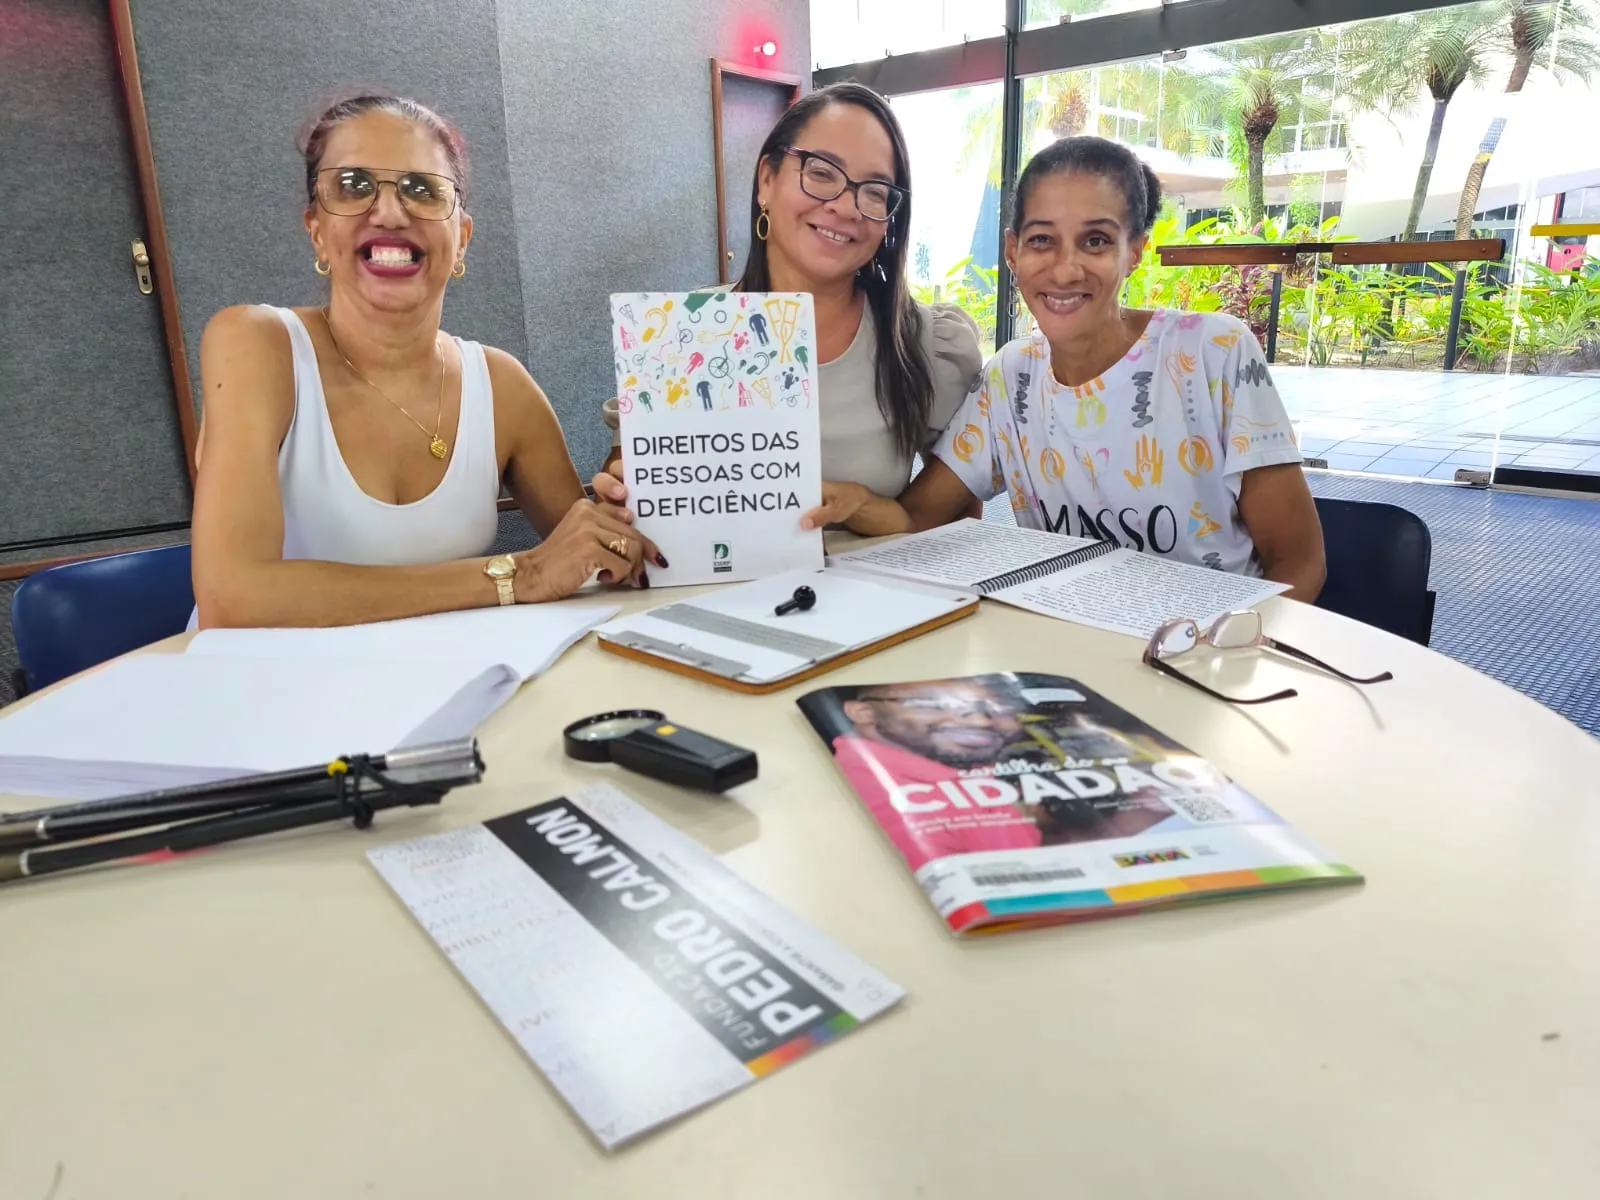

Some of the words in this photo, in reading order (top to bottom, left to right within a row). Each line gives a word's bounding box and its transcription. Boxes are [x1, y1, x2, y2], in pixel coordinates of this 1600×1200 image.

[633, 433, 745, 456] DIREITOS
[752, 431, 799, 453] DAS
[635, 464, 743, 485] PESSOAS
[751, 462, 800, 480] COM
[637, 490, 800, 518] DEFICIÊNCIA
[525, 806, 671, 911] CALMON
[653, 954, 769, 1051] FUNDAÇÃO
[654, 911, 823, 1036] PEDRO
